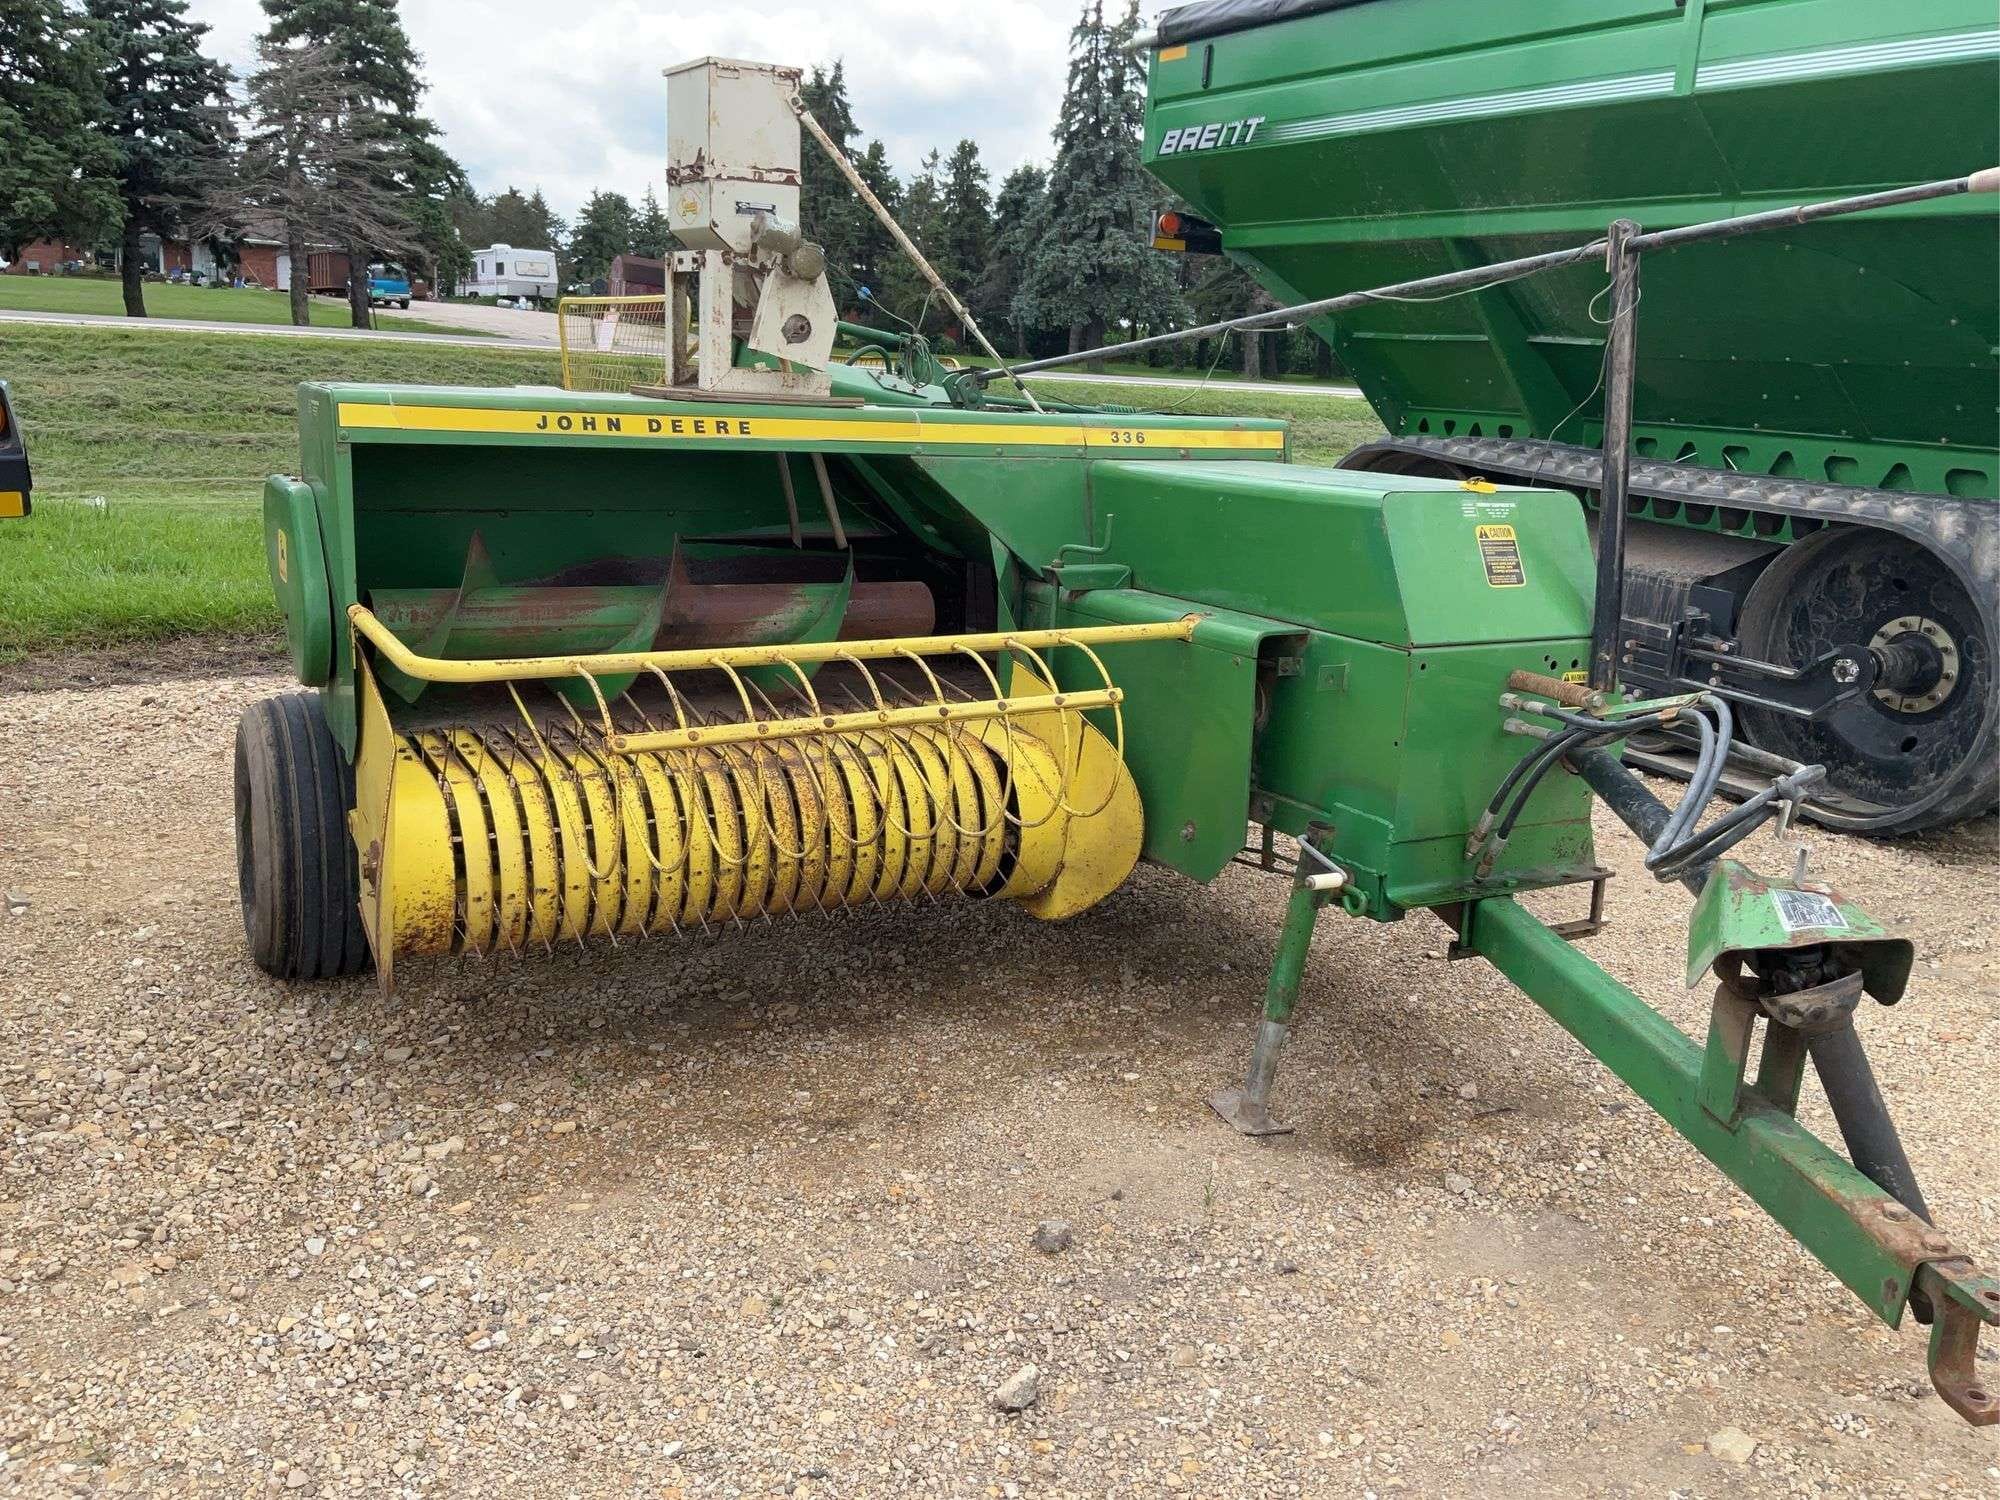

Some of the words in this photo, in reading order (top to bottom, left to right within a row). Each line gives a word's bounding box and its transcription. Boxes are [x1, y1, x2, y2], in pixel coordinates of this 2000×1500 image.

[1159, 116, 1265, 154] BRENT
[536, 415, 621, 432] JOHN
[648, 418, 751, 435] DEERE
[1111, 431, 1146, 444] 336
[1489, 527, 1512, 538] CAUTION
